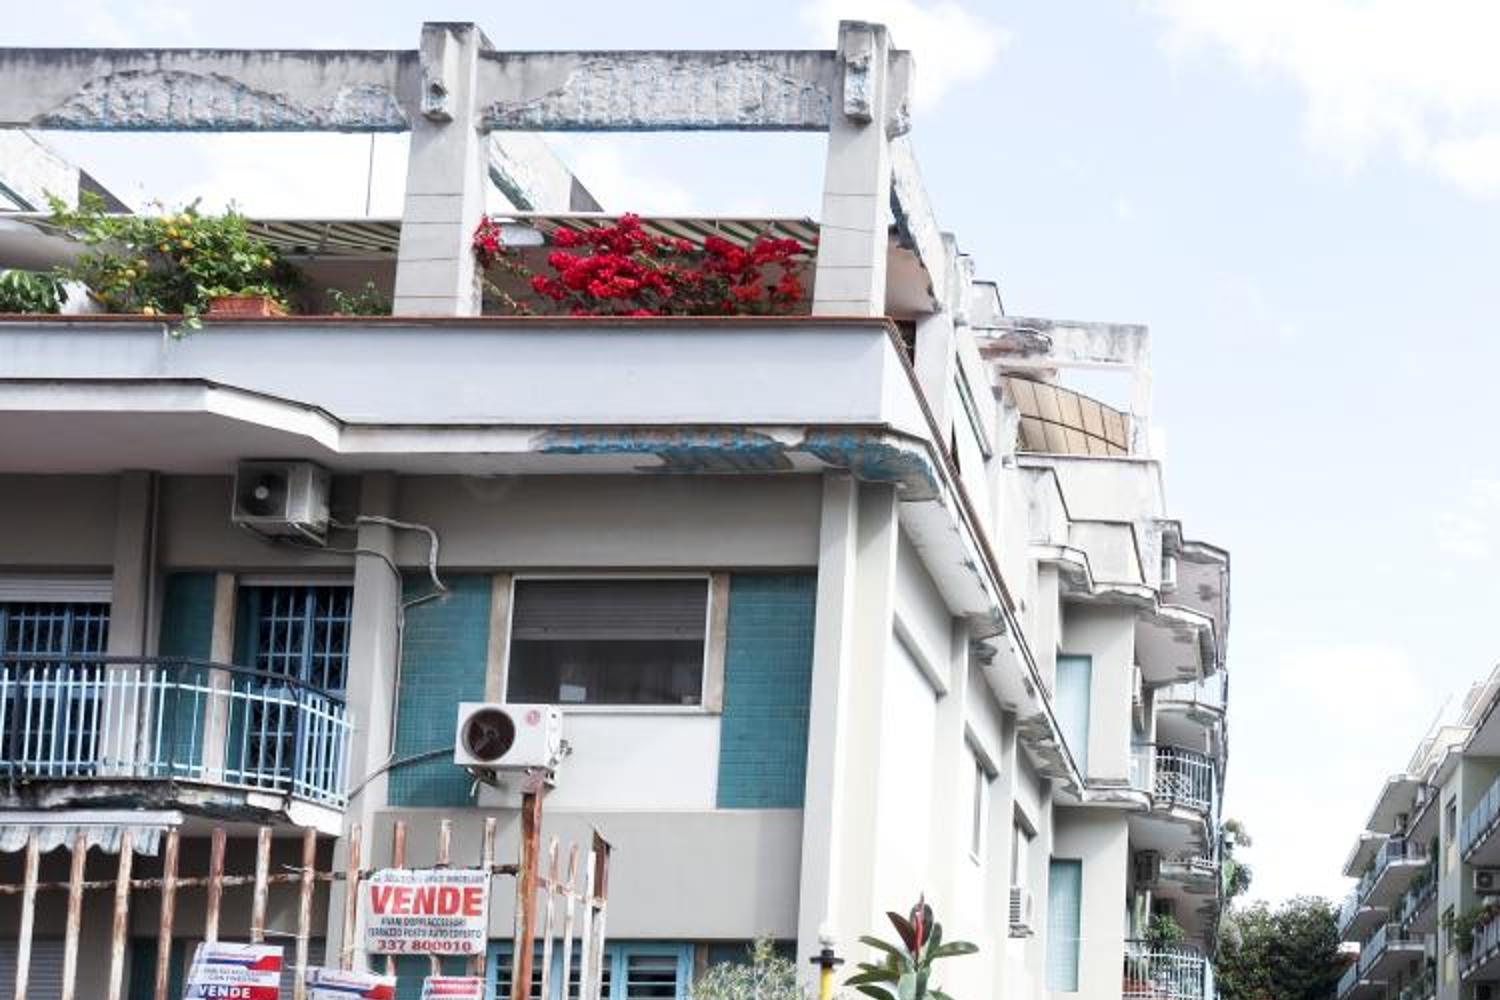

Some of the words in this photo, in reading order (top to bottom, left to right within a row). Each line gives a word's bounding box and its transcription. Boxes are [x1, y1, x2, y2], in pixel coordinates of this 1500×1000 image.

[371, 885, 482, 916] VENDE
[377, 939, 406, 952] 337
[411, 940, 472, 952] 800010
[199, 985, 251, 999] VENDE
